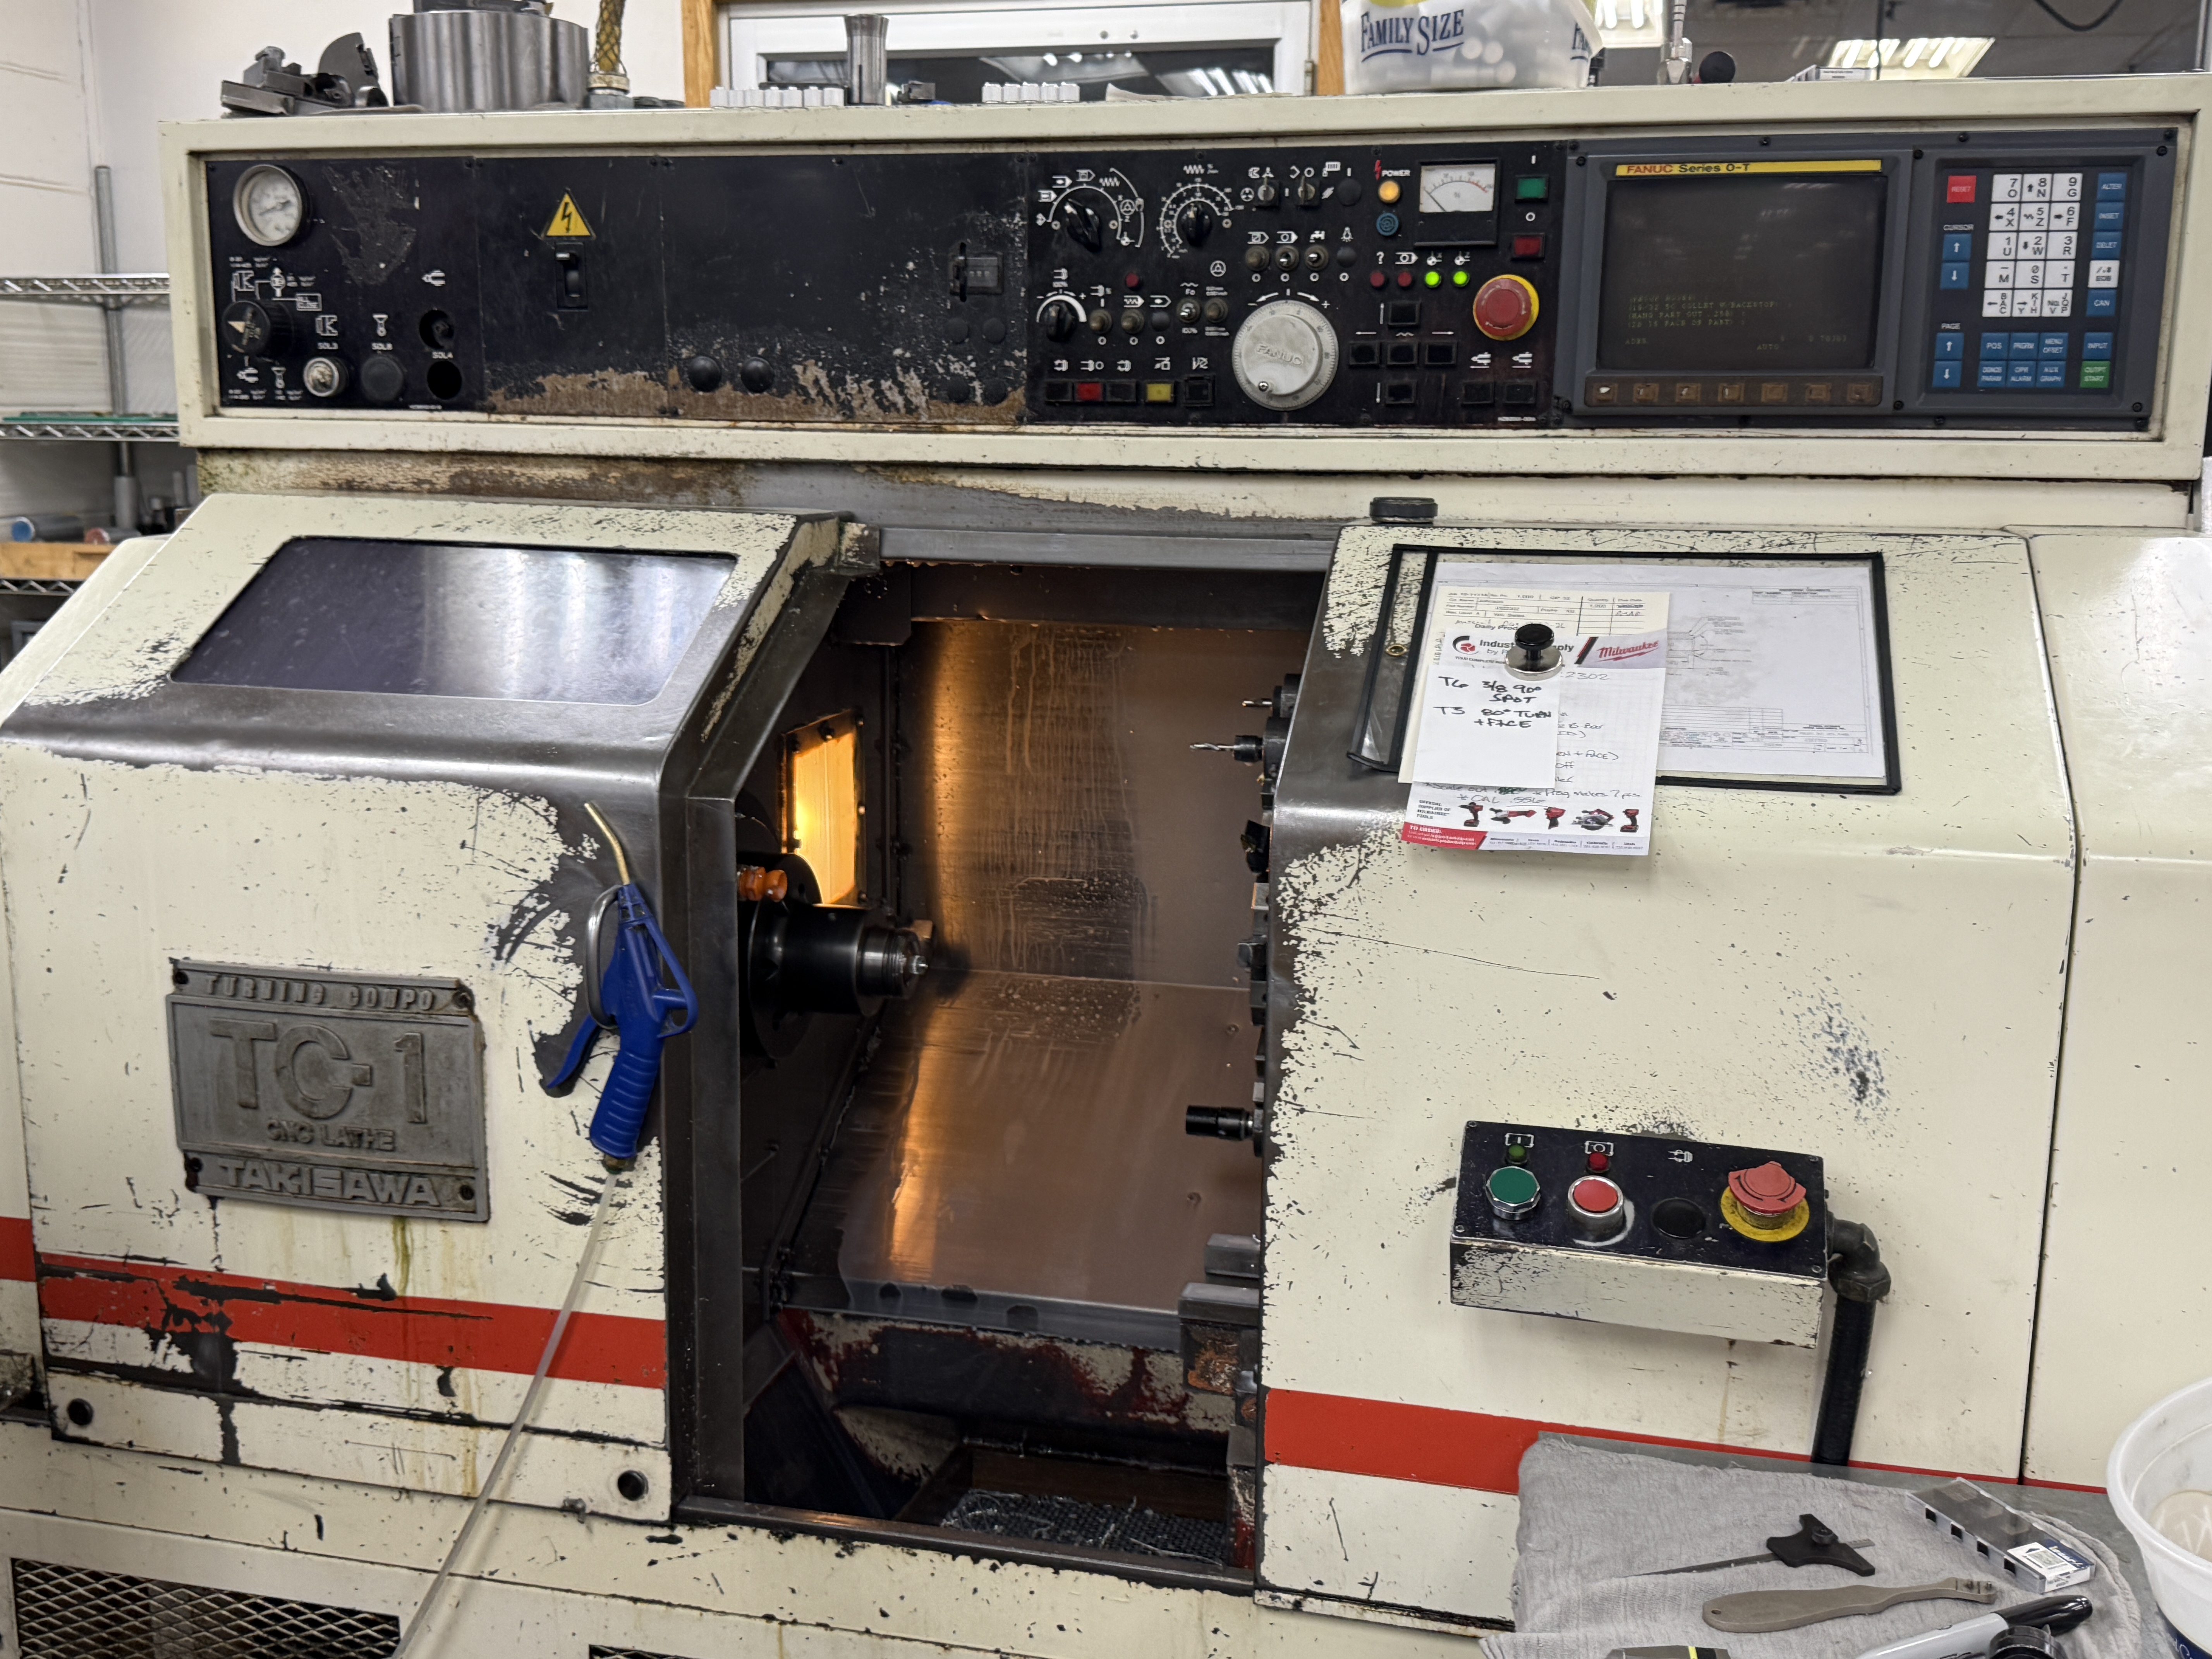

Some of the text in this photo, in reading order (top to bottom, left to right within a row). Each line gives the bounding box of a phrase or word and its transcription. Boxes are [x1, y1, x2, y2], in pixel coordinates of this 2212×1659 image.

[1360, 9, 1464, 55] FAMILY SIZE
[1627, 164, 1673, 174] FANUC
[1679, 164, 1721, 172] Series
[2009, 178, 2018, 188] 7
[2038, 178, 2047, 187] 8
[2069, 177, 2077, 187] 9
[2037, 189, 2047, 198] N
[2067, 188, 2078, 198] G
[2006, 208, 2015, 216] 4
[2037, 207, 2044, 215] 5
[2067, 206, 2075, 215] 6
[2005, 218, 2014, 227] X
[2035, 218, 2044, 227] Z
[2066, 218, 2074, 226] F
[2006, 237, 2011, 246] 1
[2034, 237, 2042, 246] 2
[2064, 236, 2073, 245] 3
[2003, 247, 2012, 256] U
[2032, 247, 2045, 256] W
[2063, 247, 2072, 255] R
[1999, 275, 2009, 283] M
[2030, 275, 2039, 283] S
[2061, 274, 2069, 282] T
[1479, 639, 1515, 648] Indust
[1597, 640, 1659, 658] Milwaukee
[1438, 676, 1469, 688] T6
[1482, 680, 1508, 693] 3/8
[1489, 693, 1537, 704] SPOT
[205, 974, 436, 1010] TURNING COMPO
[266, 1118, 396, 1152] CNC LATHE
[220, 1163, 440, 1207] TAKISAWA
